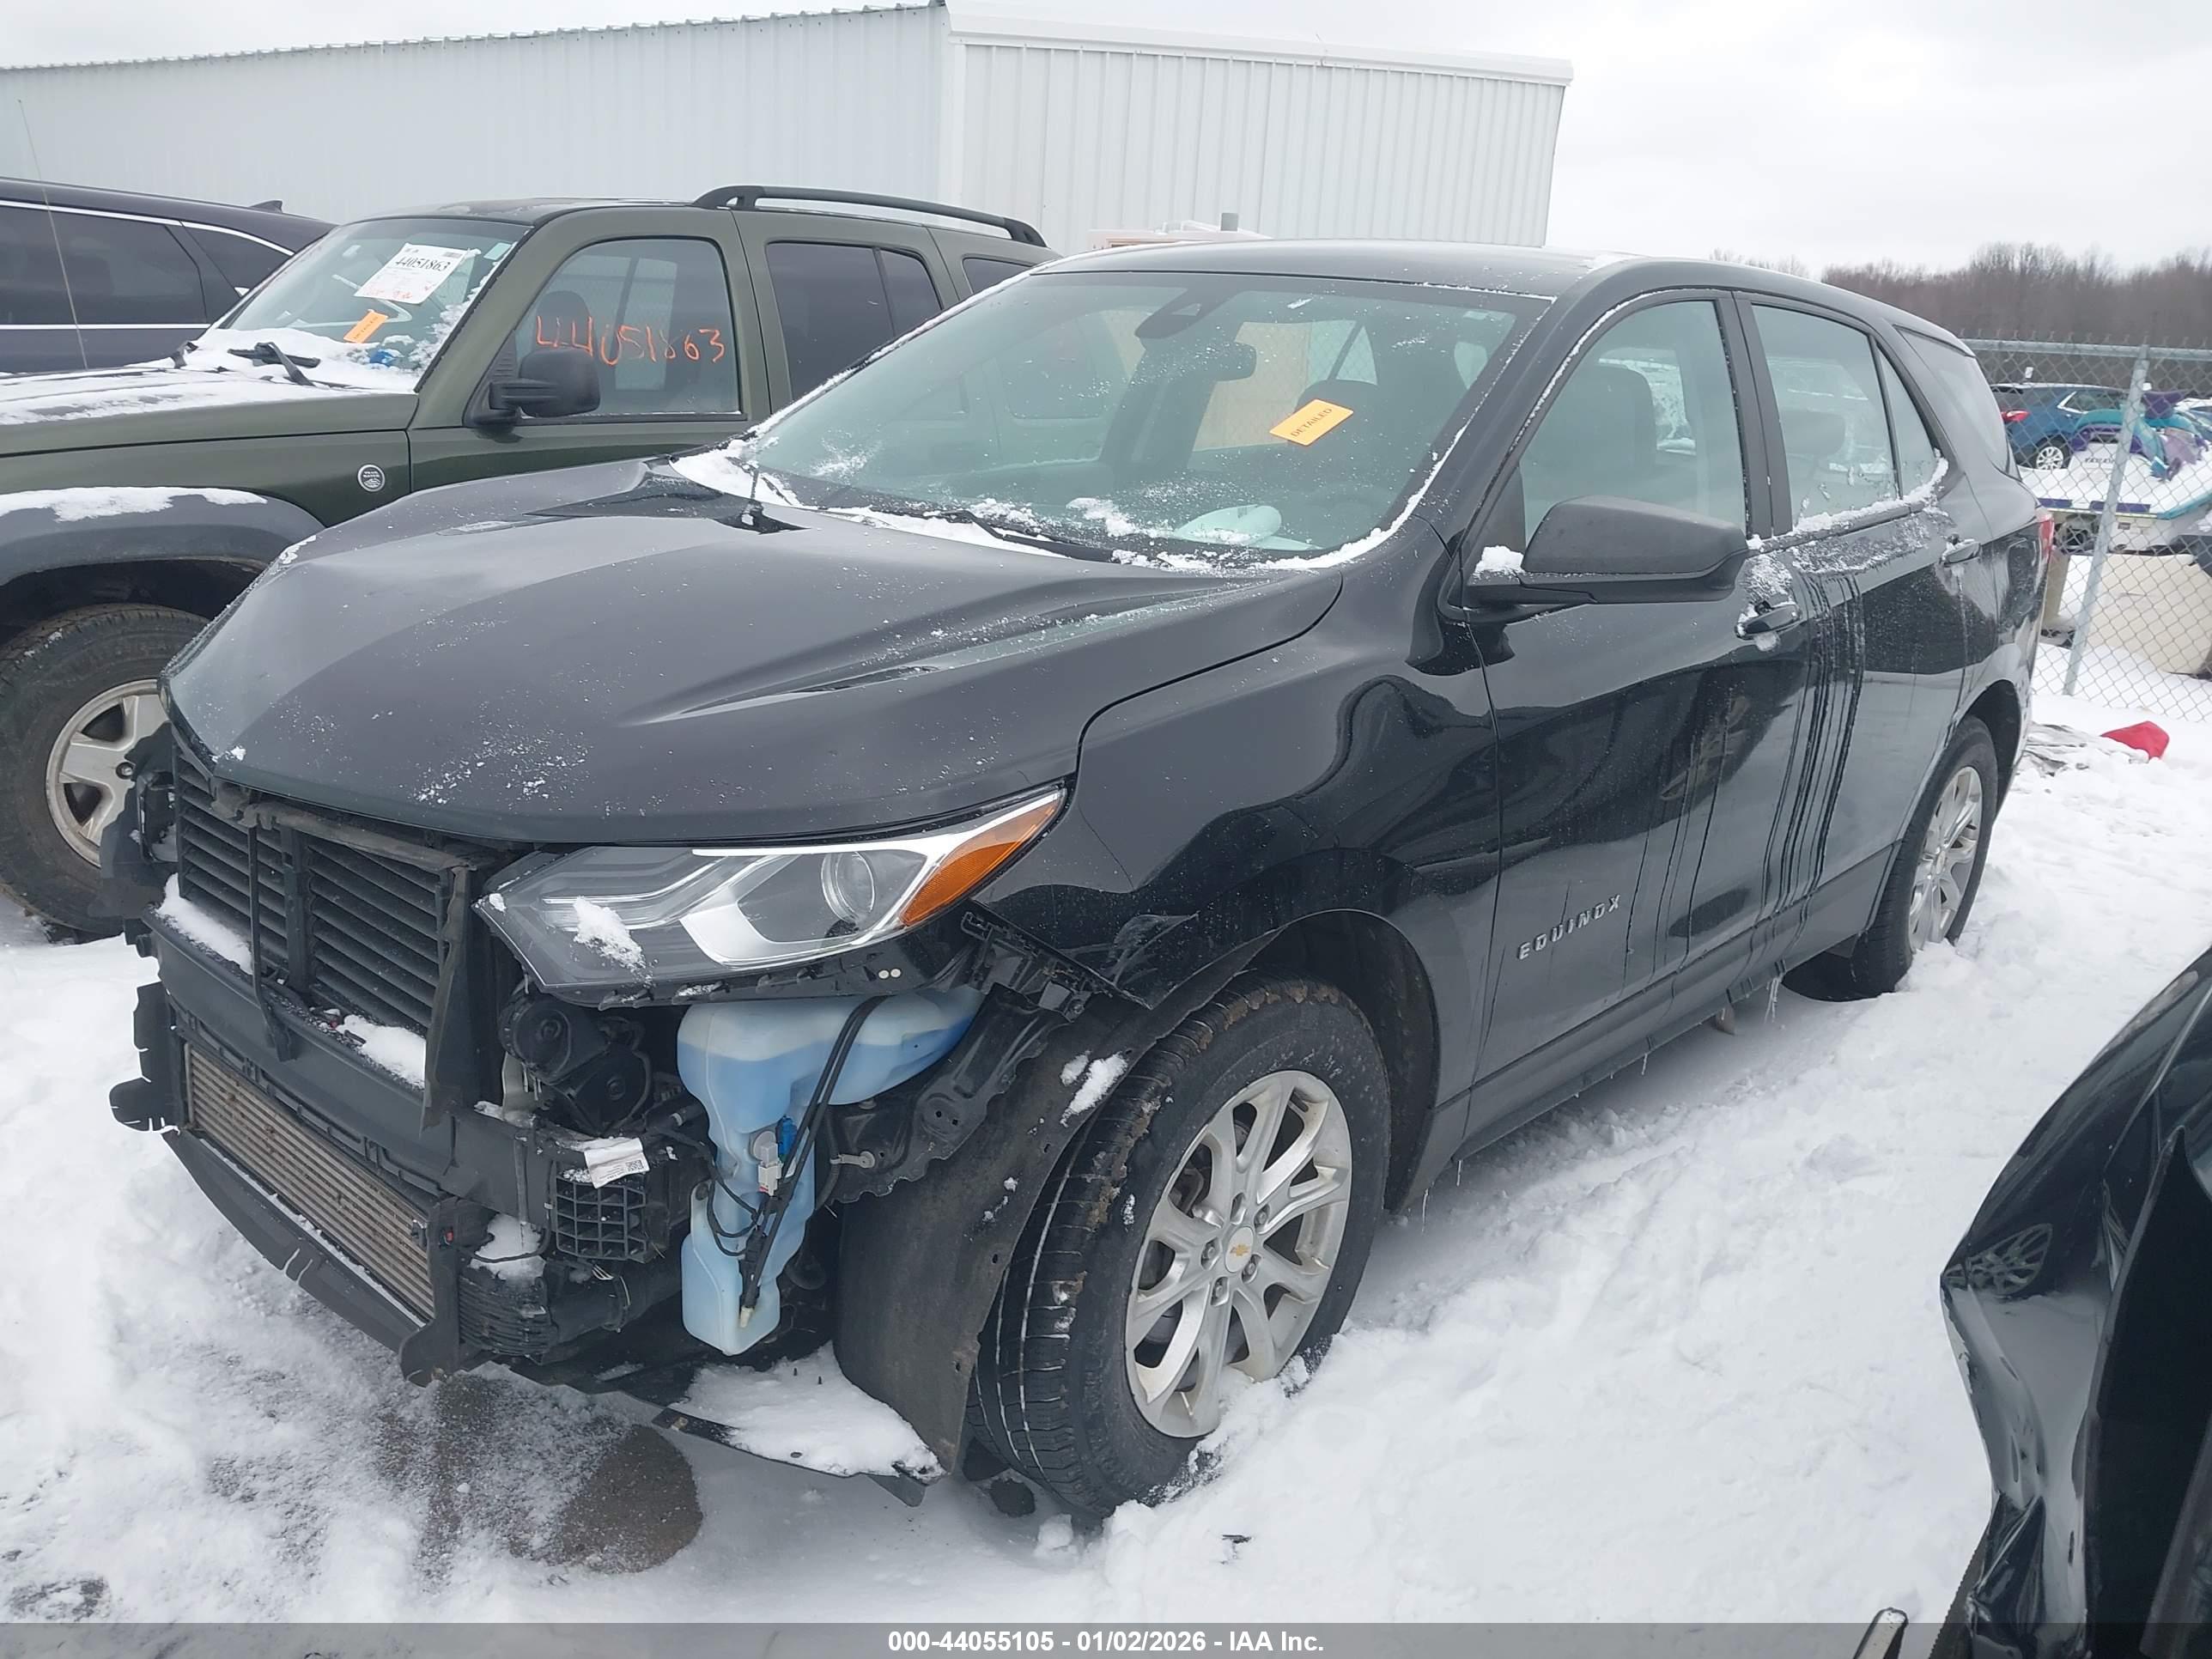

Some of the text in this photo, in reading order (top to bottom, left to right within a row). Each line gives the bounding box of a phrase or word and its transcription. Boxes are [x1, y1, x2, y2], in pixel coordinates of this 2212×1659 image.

[396, 255, 451, 272] 44051863
[536, 314, 726, 366] 44051863
[1290, 408, 1333, 437] DETAILED
[1516, 894, 1621, 961] EQUINOX
